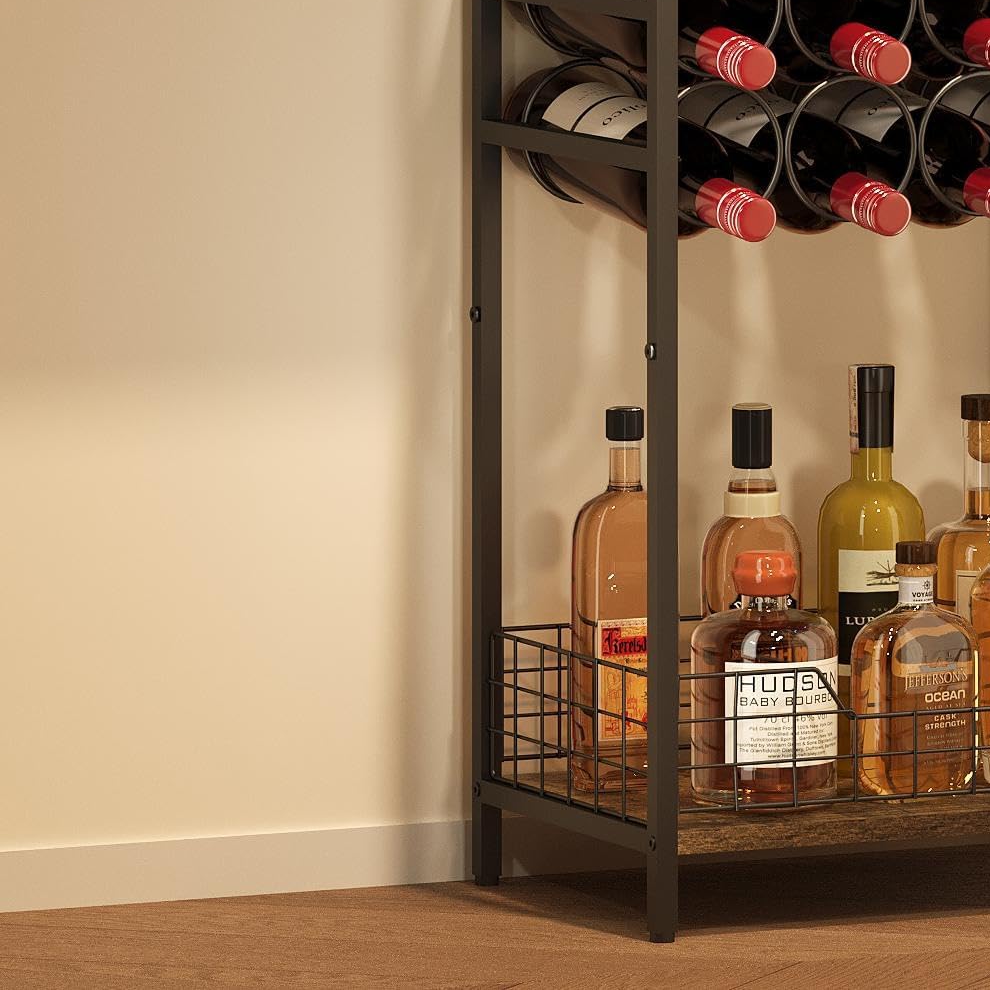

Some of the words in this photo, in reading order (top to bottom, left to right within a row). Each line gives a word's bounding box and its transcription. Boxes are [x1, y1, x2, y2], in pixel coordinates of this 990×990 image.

[740, 671, 836, 693] HUDSON
[904, 670, 968, 692] JEFFERSON'S
[740, 697, 779, 707] BABY
[785, 692, 834, 706] BOURBO
[934, 713, 957, 722] CASK
